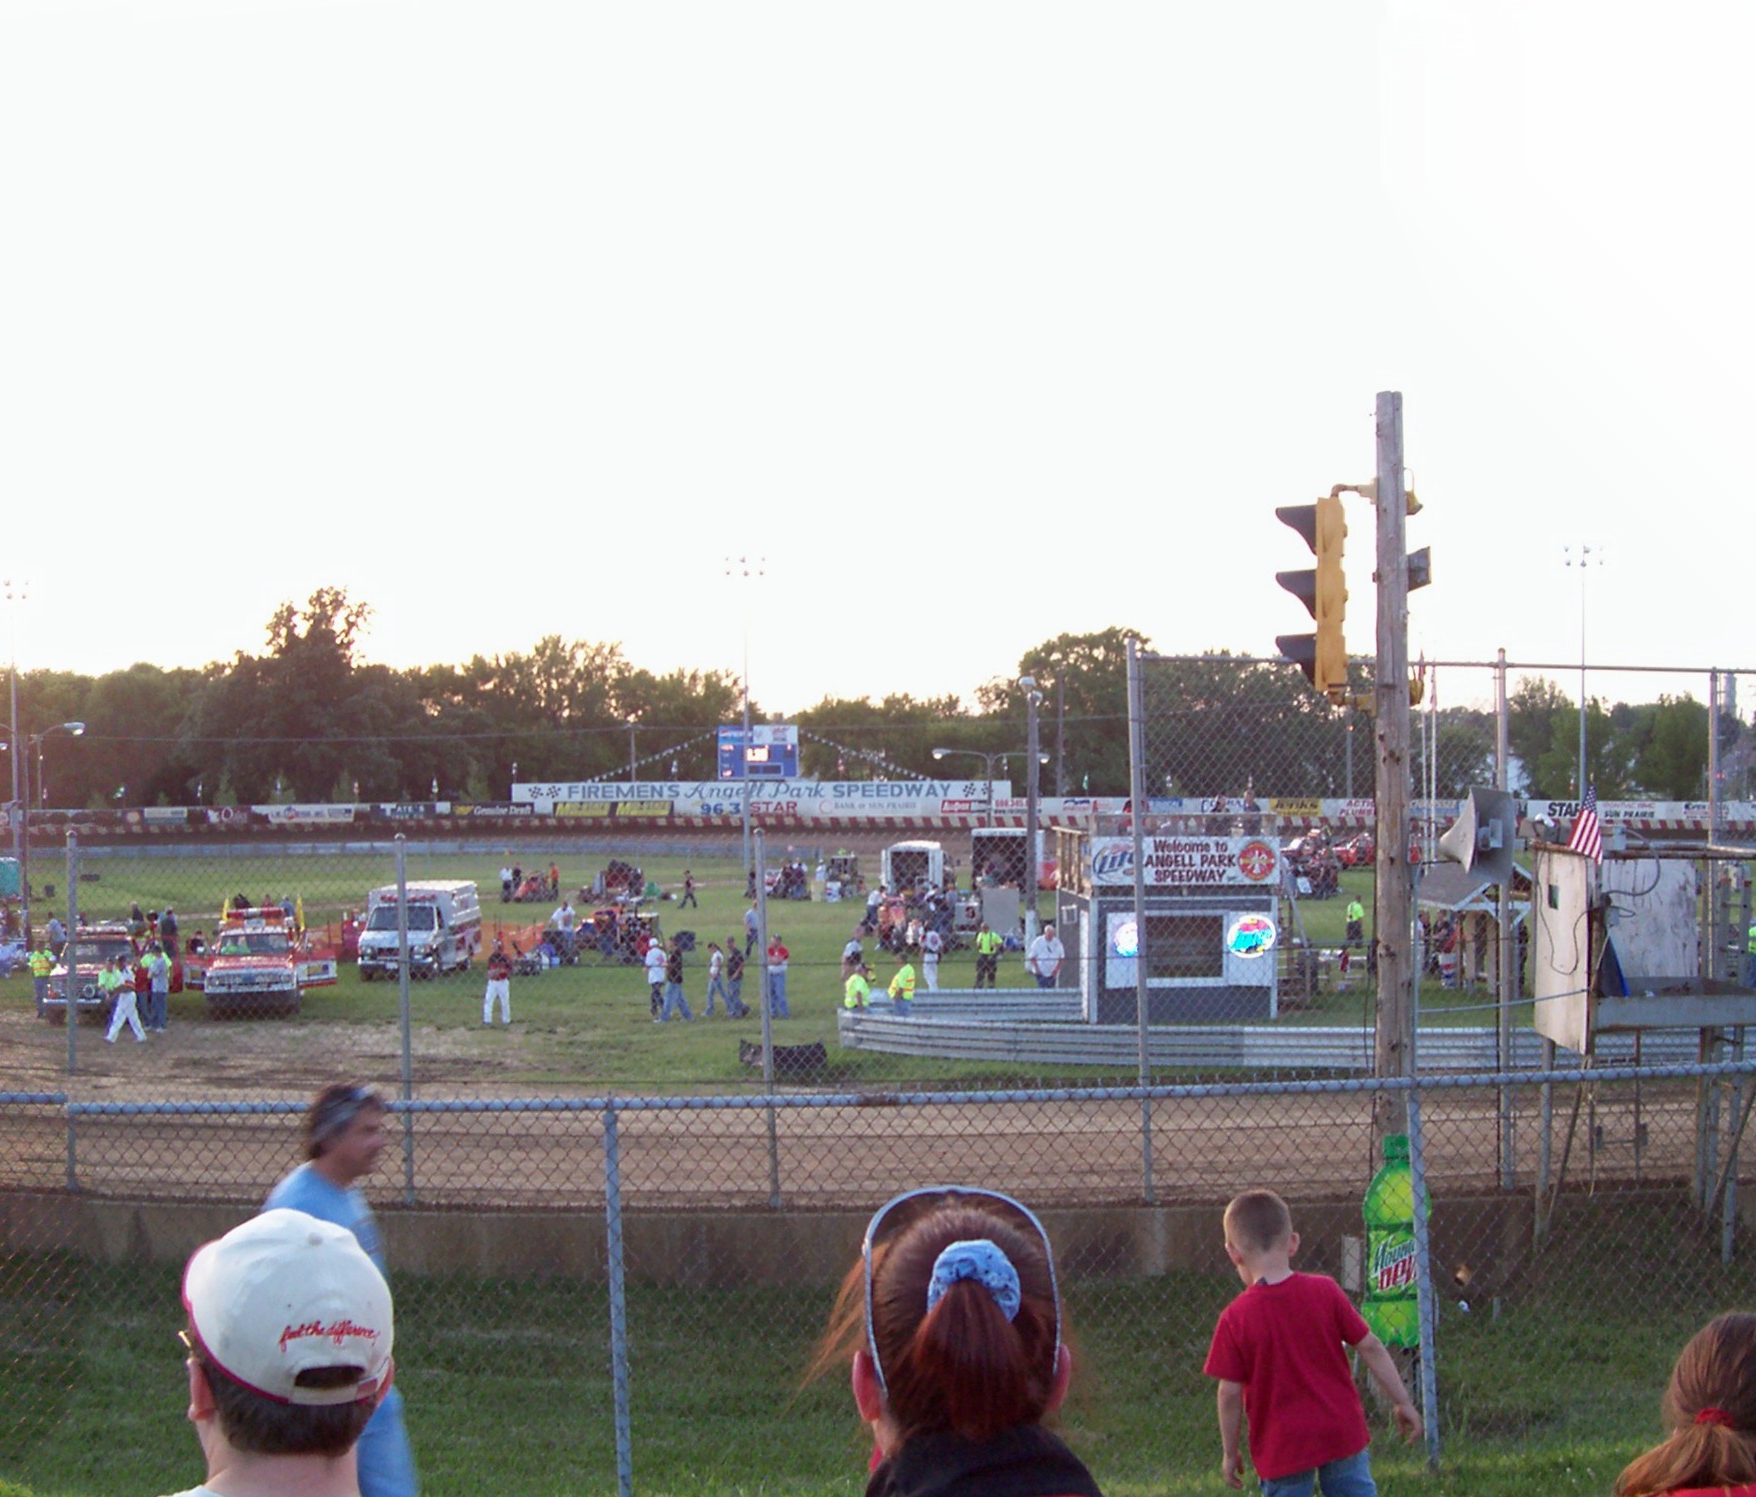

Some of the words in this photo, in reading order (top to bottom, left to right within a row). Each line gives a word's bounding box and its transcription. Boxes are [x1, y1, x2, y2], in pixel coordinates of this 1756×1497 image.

[567, 784, 680, 799] FIREMEN'S
[685, 781, 765, 800] Angell
[767, 782, 825, 799] Park
[832, 783, 951, 798] SPEEDWAY
[508, 805, 533, 815] Draft
[749, 801, 798, 814] STAR
[1153, 840, 1210, 853] Welcome
[1214, 841, 1228, 853] to
[1145, 854, 1196, 868] ANGELL
[1200, 854, 1236, 868] PARK
[1154, 869, 1227, 883] SPEEDWAY
